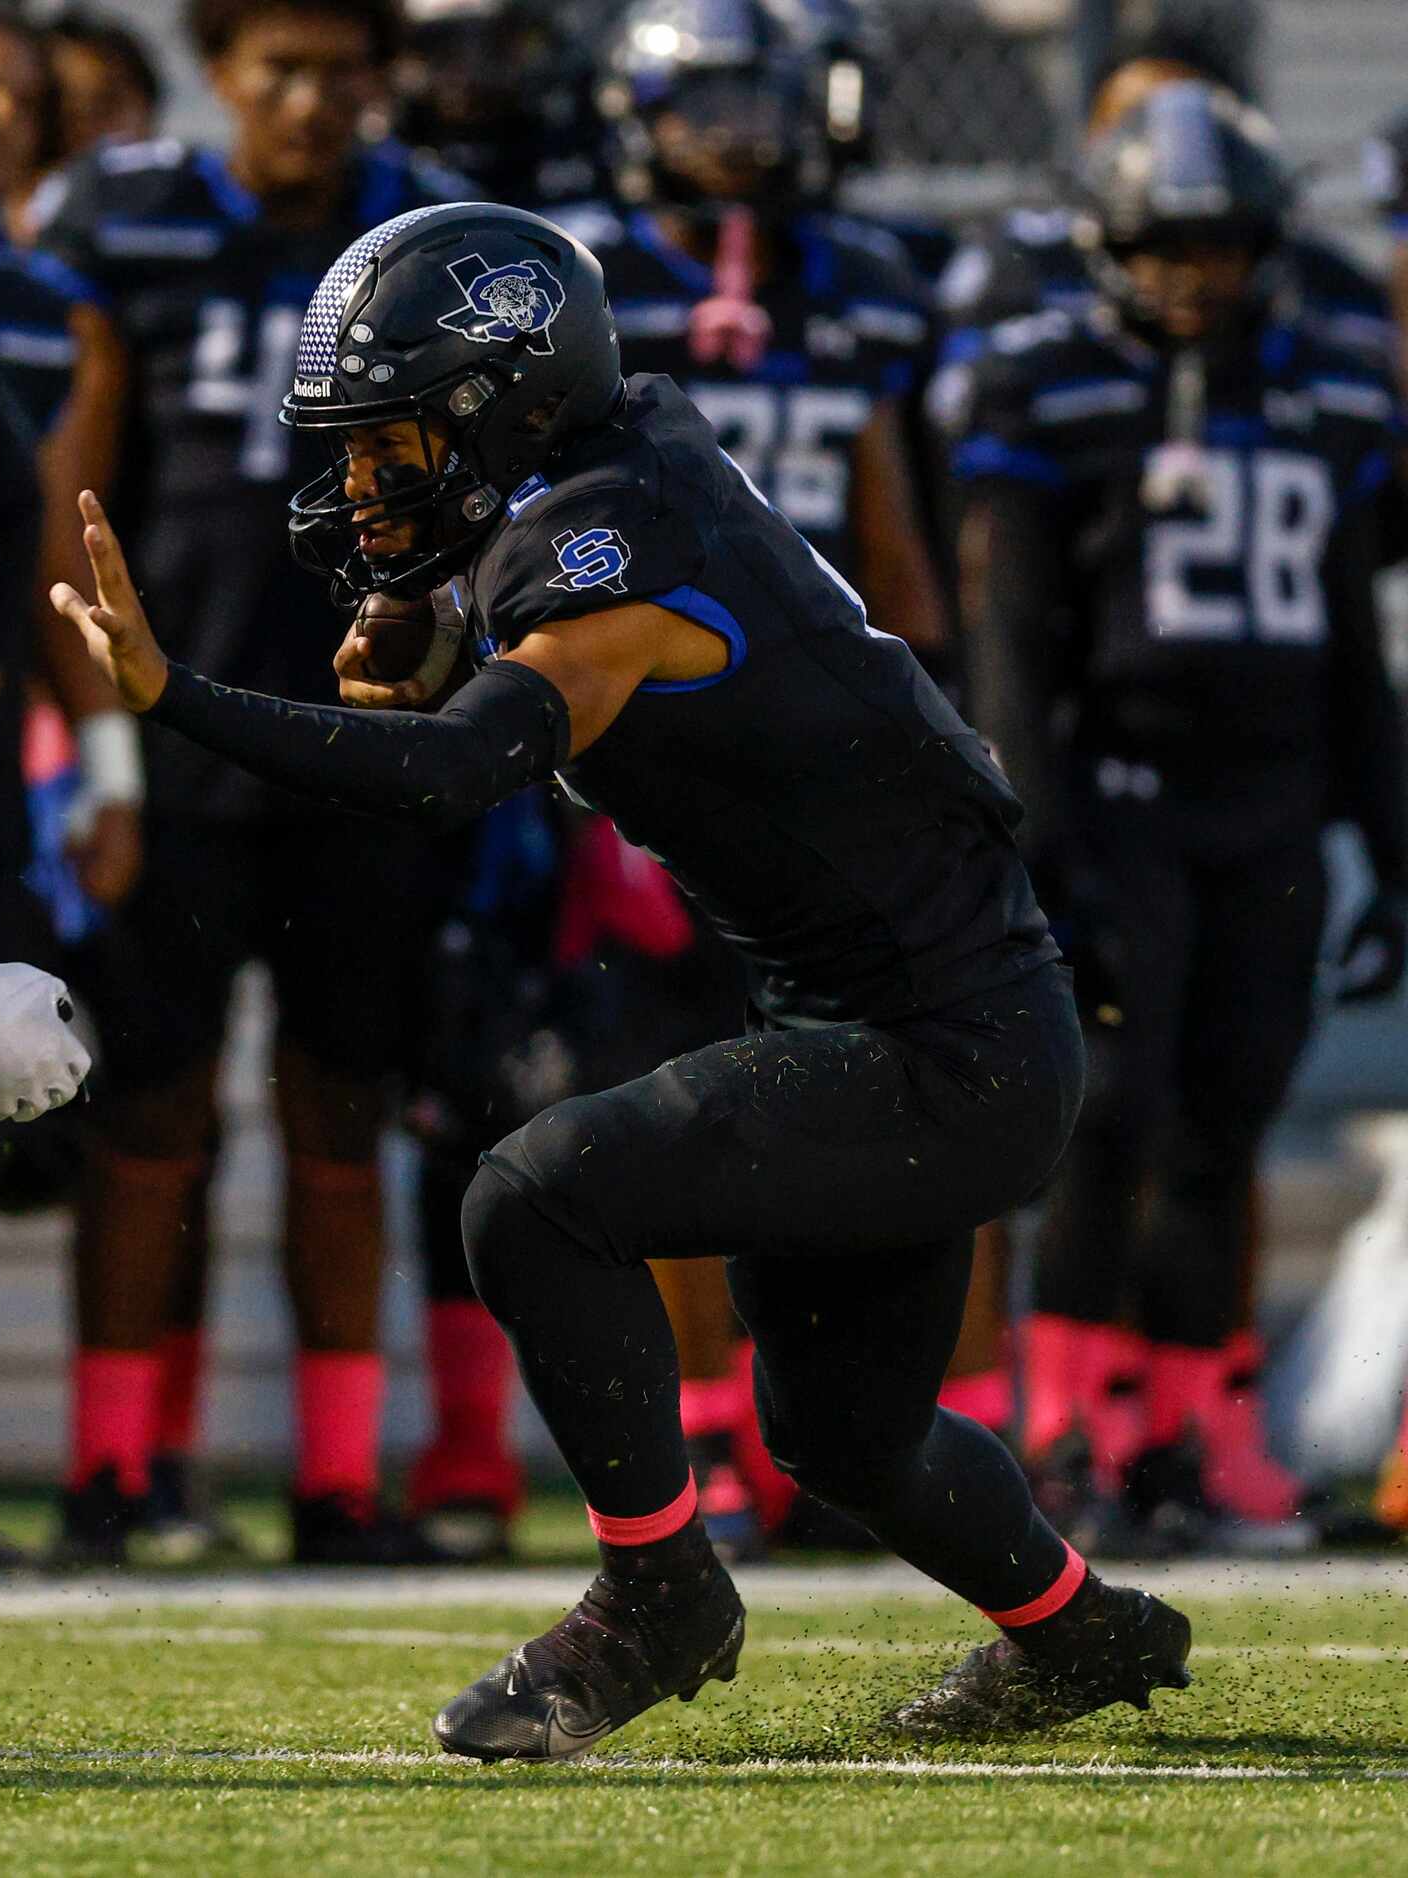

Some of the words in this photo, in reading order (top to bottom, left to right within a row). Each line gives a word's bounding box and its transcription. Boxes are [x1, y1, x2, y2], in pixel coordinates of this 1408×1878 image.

[294, 378, 331, 397] Riddell
[557, 528, 626, 588] S
[1140, 450, 1334, 640] 28
